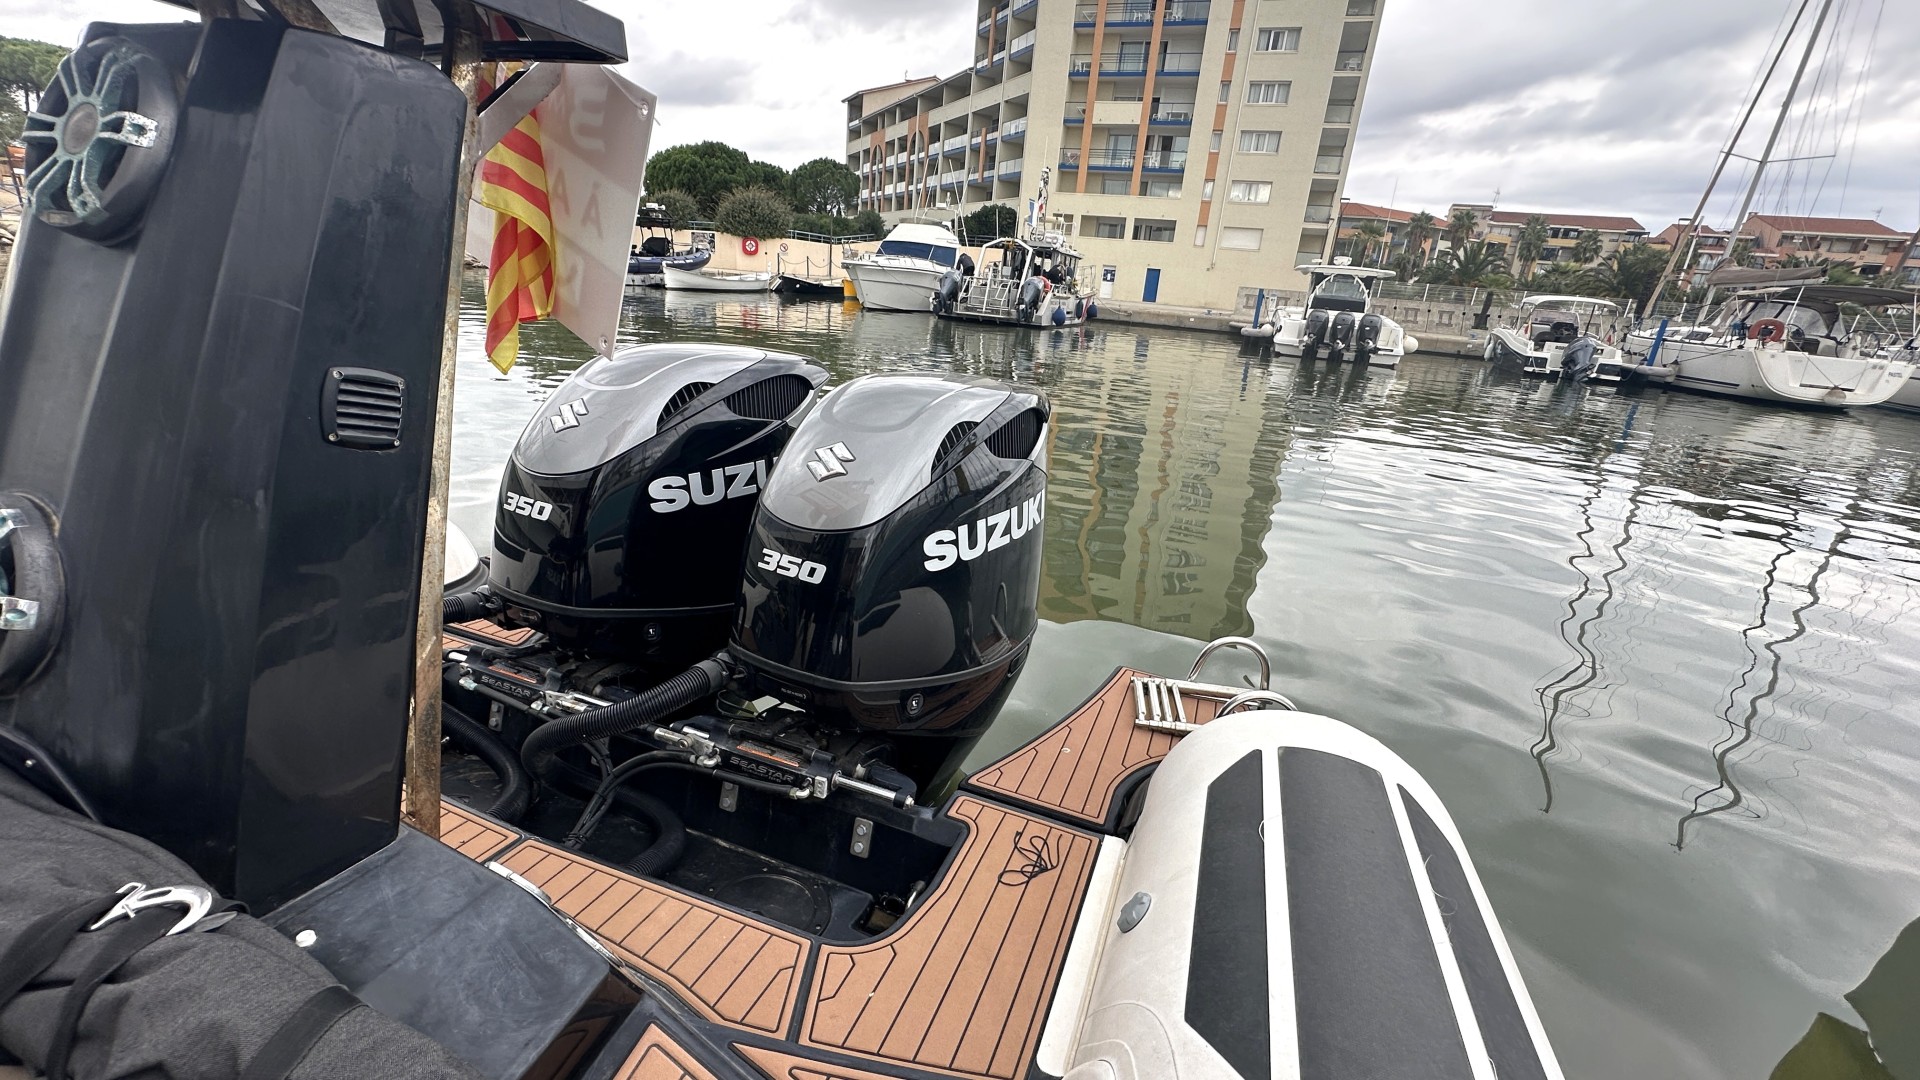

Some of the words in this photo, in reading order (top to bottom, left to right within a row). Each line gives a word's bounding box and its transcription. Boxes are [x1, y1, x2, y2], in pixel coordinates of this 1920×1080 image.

[648, 456, 778, 513] SUZ
[503, 491, 553, 521] 350
[923, 488, 1046, 572] SUZUKI
[757, 548, 827, 585] 350
[481, 675, 531, 697] SEASTAR
[730, 756, 795, 783] SEASTAR
